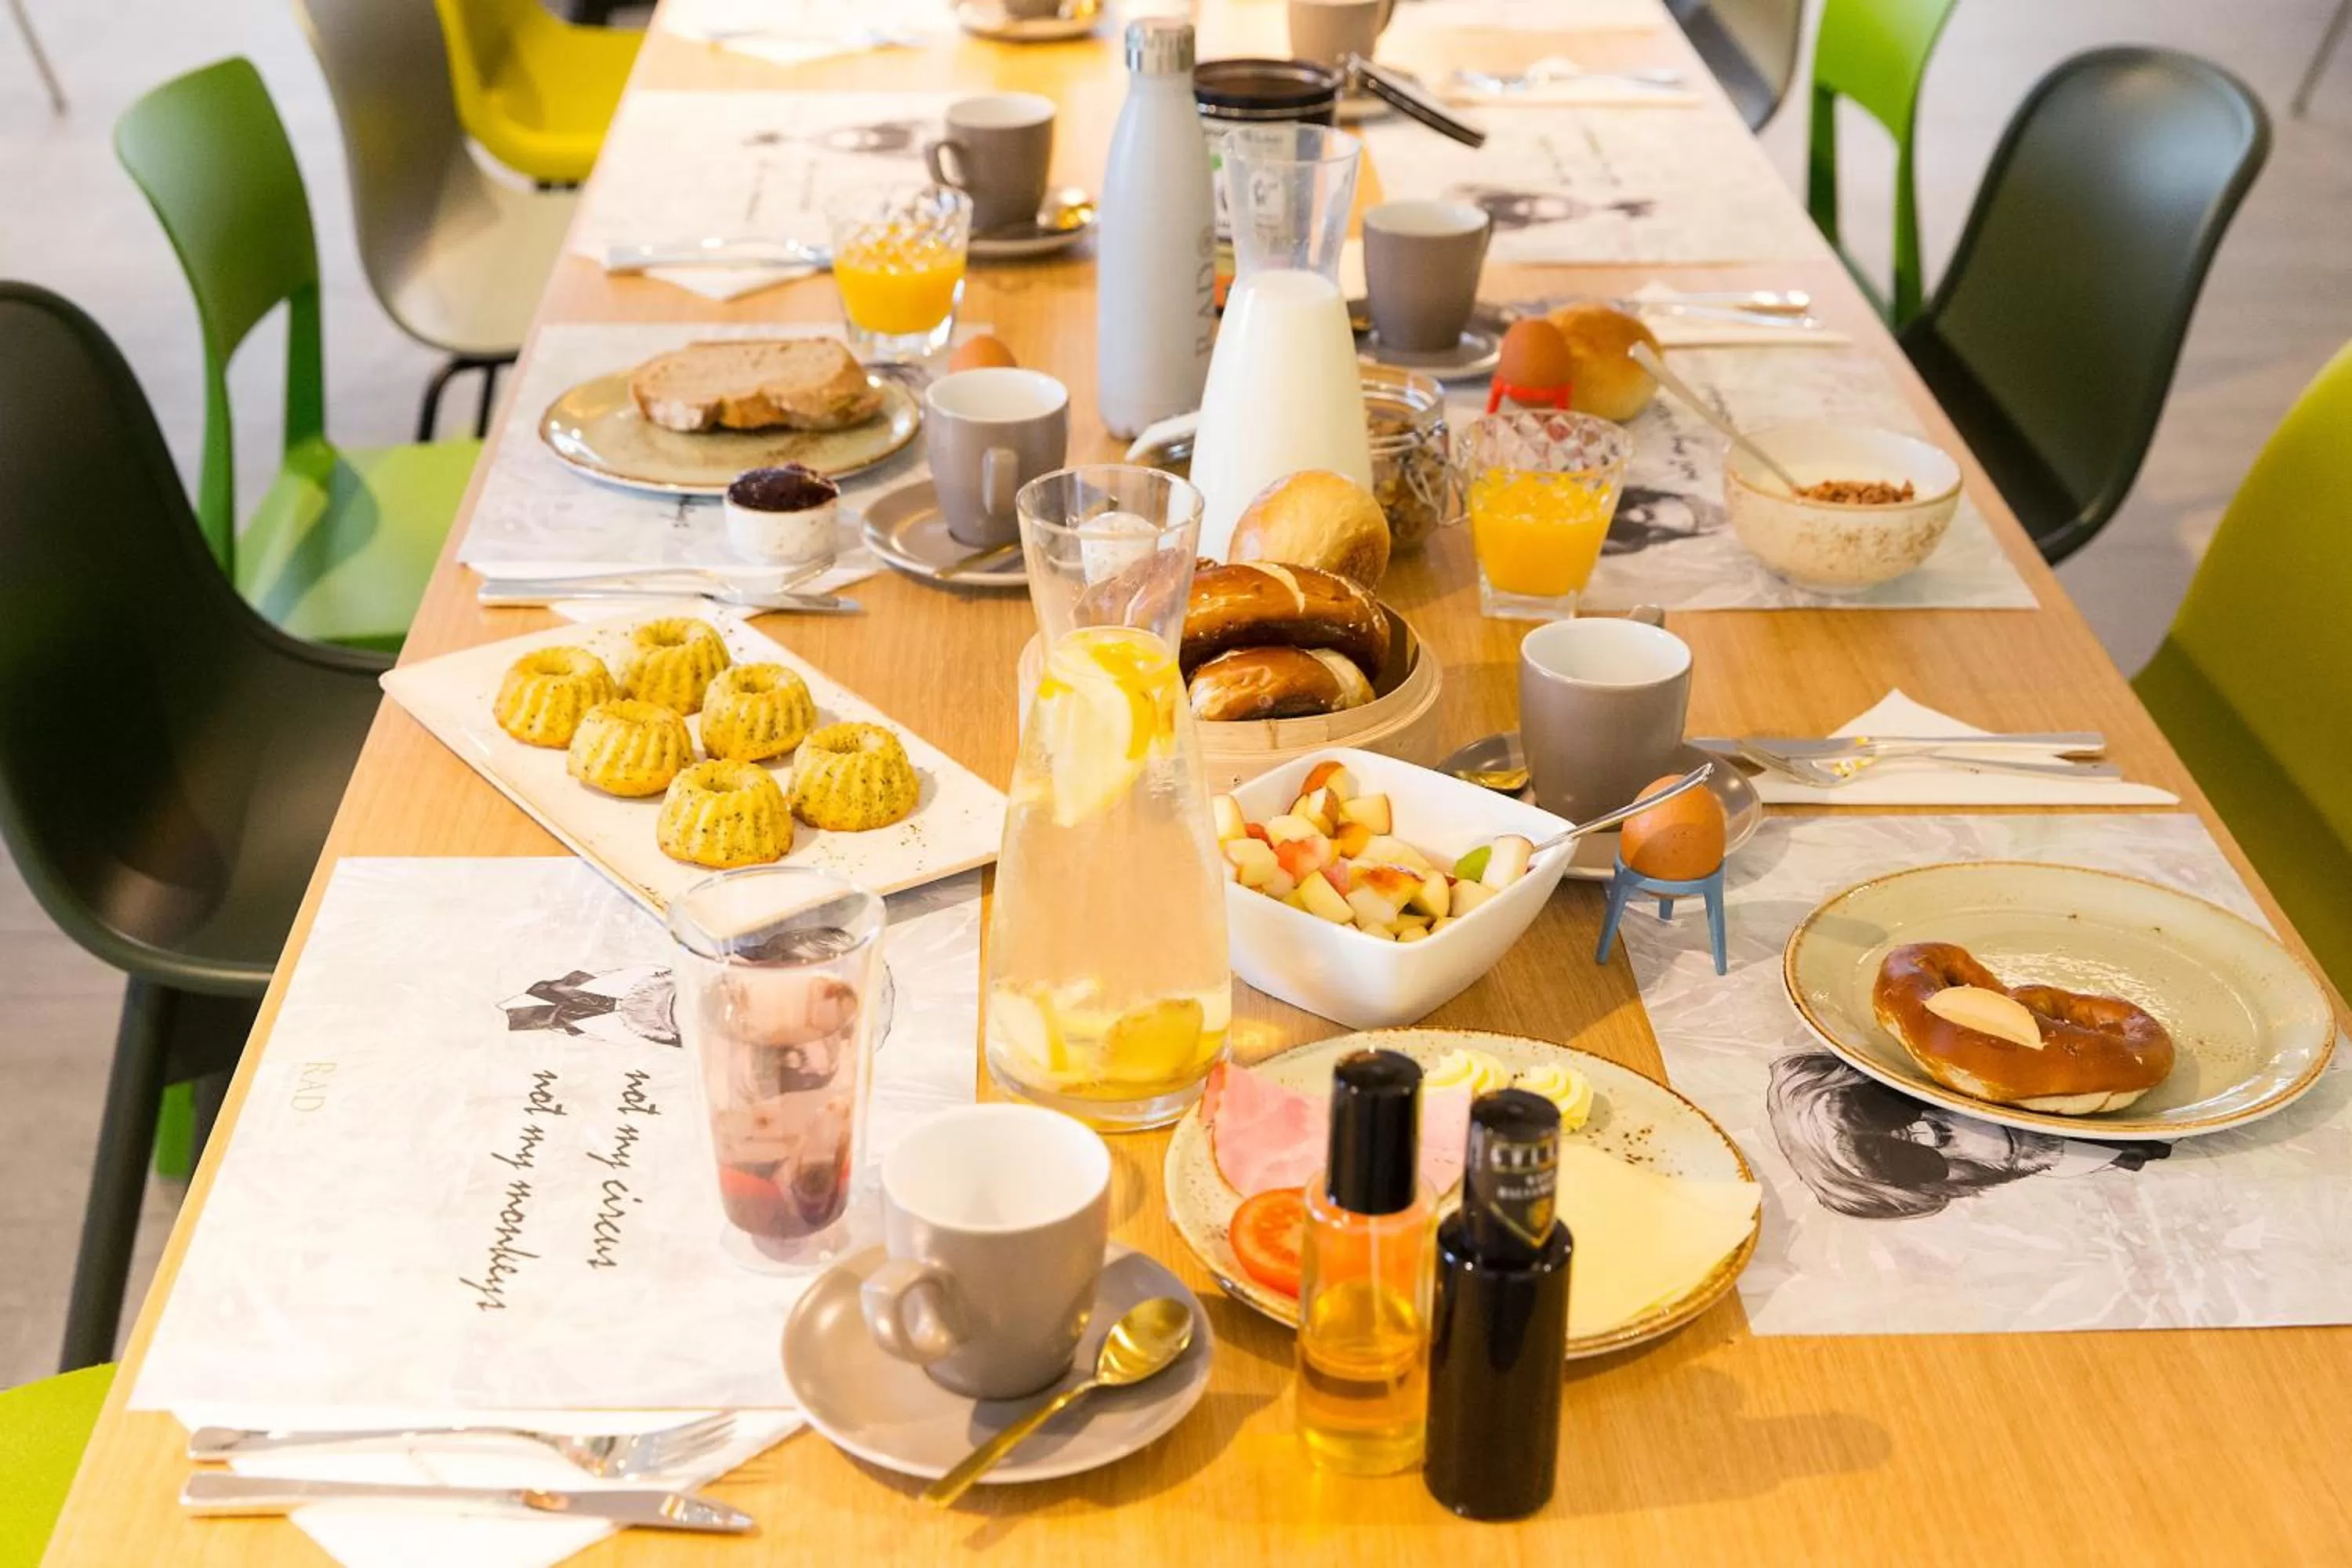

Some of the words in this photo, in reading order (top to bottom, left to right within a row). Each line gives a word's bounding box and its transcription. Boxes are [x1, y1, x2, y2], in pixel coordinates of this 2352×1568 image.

[291, 1062, 337, 1112] RAD
[524, 1070, 568, 1116] not
[617, 1069, 662, 1115] not
[491, 1125, 544, 1170] my
[586, 1124, 639, 1169] my
[459, 1181, 539, 1311] monkeys
[586, 1180, 643, 1269] circus
